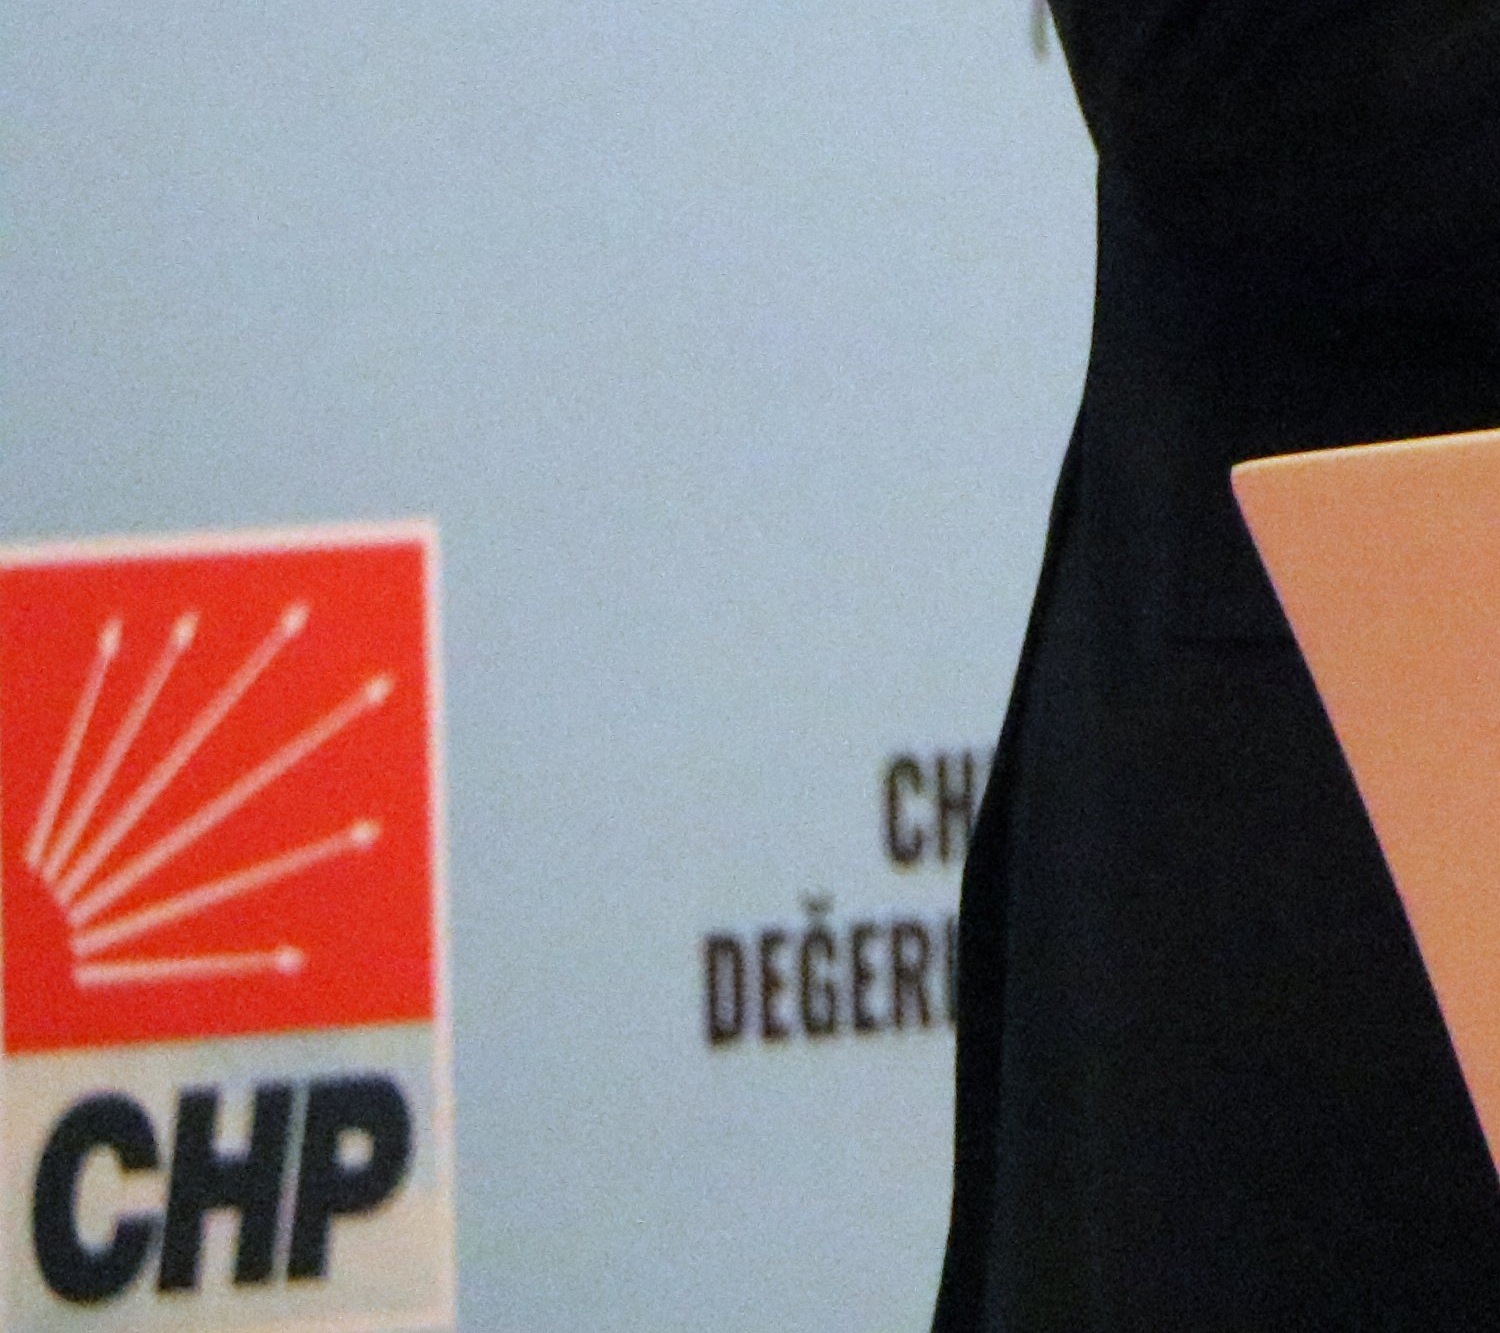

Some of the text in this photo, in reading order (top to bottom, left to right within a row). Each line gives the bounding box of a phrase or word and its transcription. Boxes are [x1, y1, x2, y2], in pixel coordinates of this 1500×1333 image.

[882, 747, 985, 870] CH
[700, 895, 957, 1050] DEĞER
[32, 1073, 417, 1306] CHP
